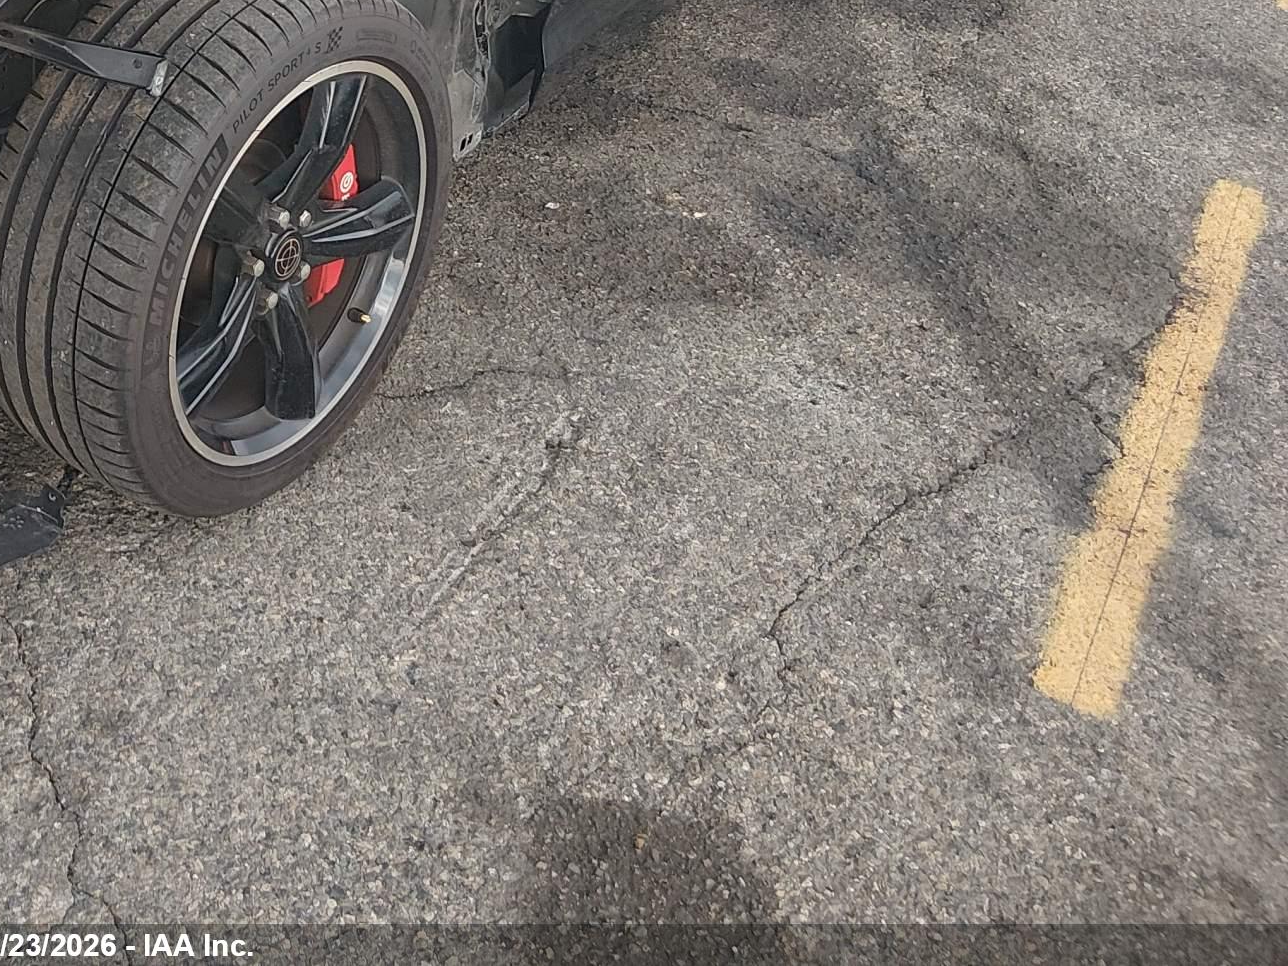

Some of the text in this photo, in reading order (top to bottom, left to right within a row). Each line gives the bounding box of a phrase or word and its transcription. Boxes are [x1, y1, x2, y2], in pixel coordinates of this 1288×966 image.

[232, 88, 264, 134] PILOT
[267, 51, 305, 92] SPORT
[148, 144, 226, 327] MICHELIN
